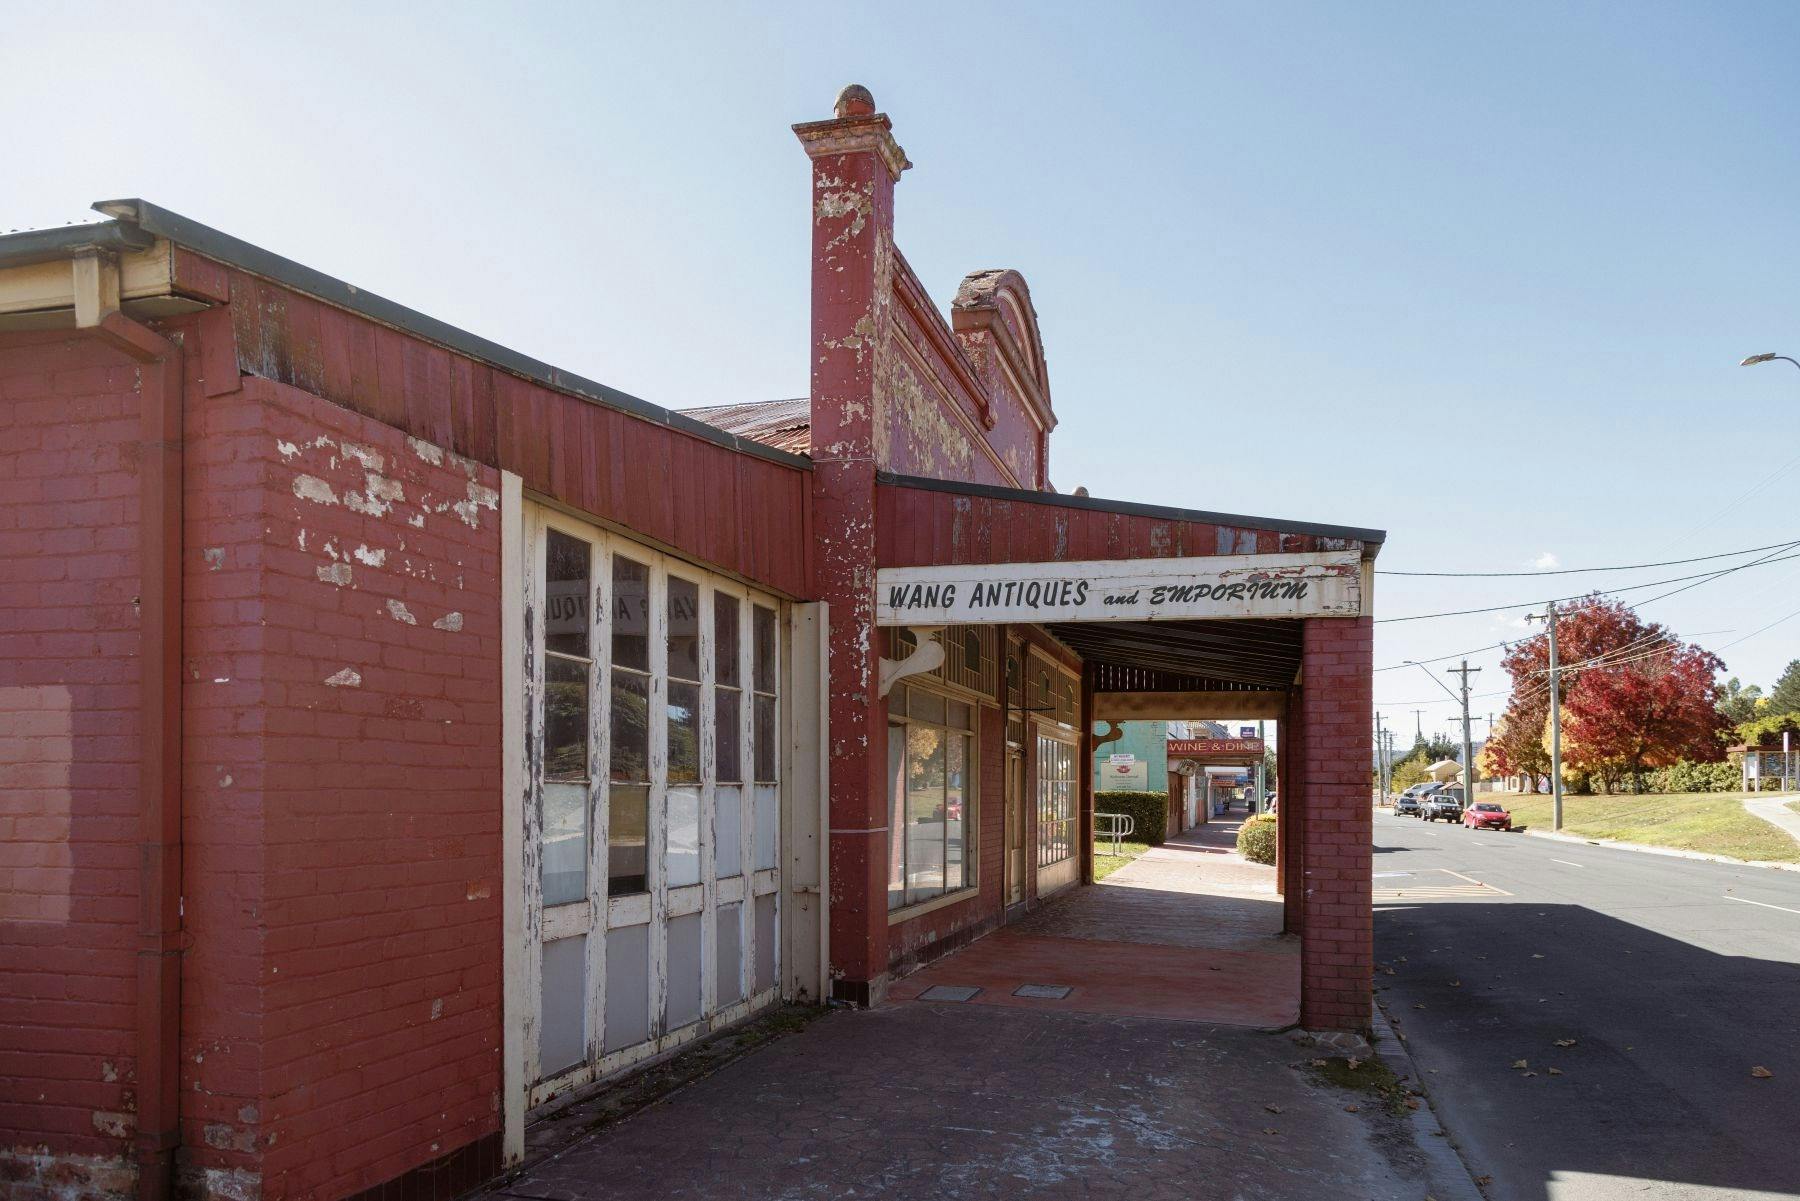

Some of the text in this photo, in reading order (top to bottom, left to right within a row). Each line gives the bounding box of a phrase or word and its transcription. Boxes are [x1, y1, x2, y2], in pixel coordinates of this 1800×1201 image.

[890, 580, 1308, 609] WANG ANTIQUES and EMPORIUM
[1169, 742, 1258, 751] WINE & DINE
